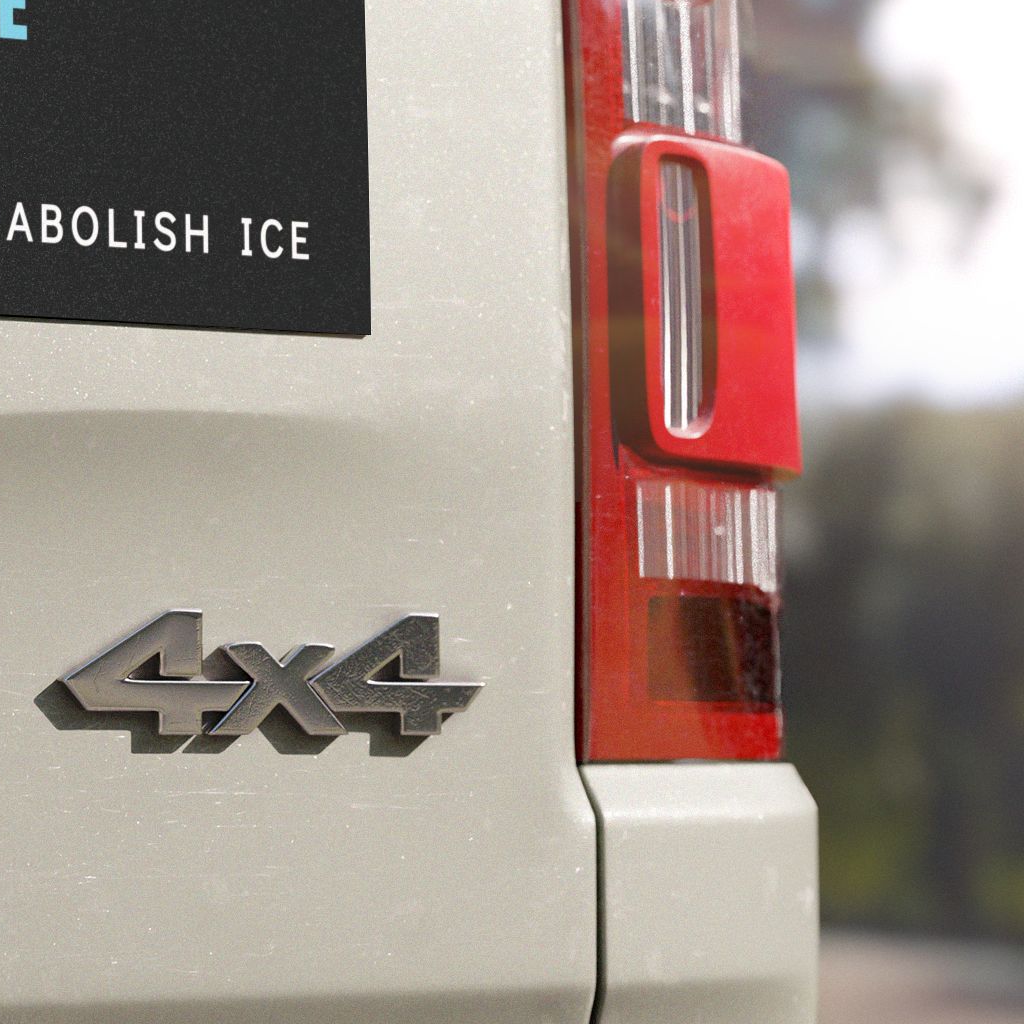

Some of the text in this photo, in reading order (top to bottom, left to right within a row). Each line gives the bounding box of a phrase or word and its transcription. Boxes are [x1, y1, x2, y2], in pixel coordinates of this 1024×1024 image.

[6, 201, 310, 261] ABOLISH ICE
[63, 608, 486, 737] 4x4
